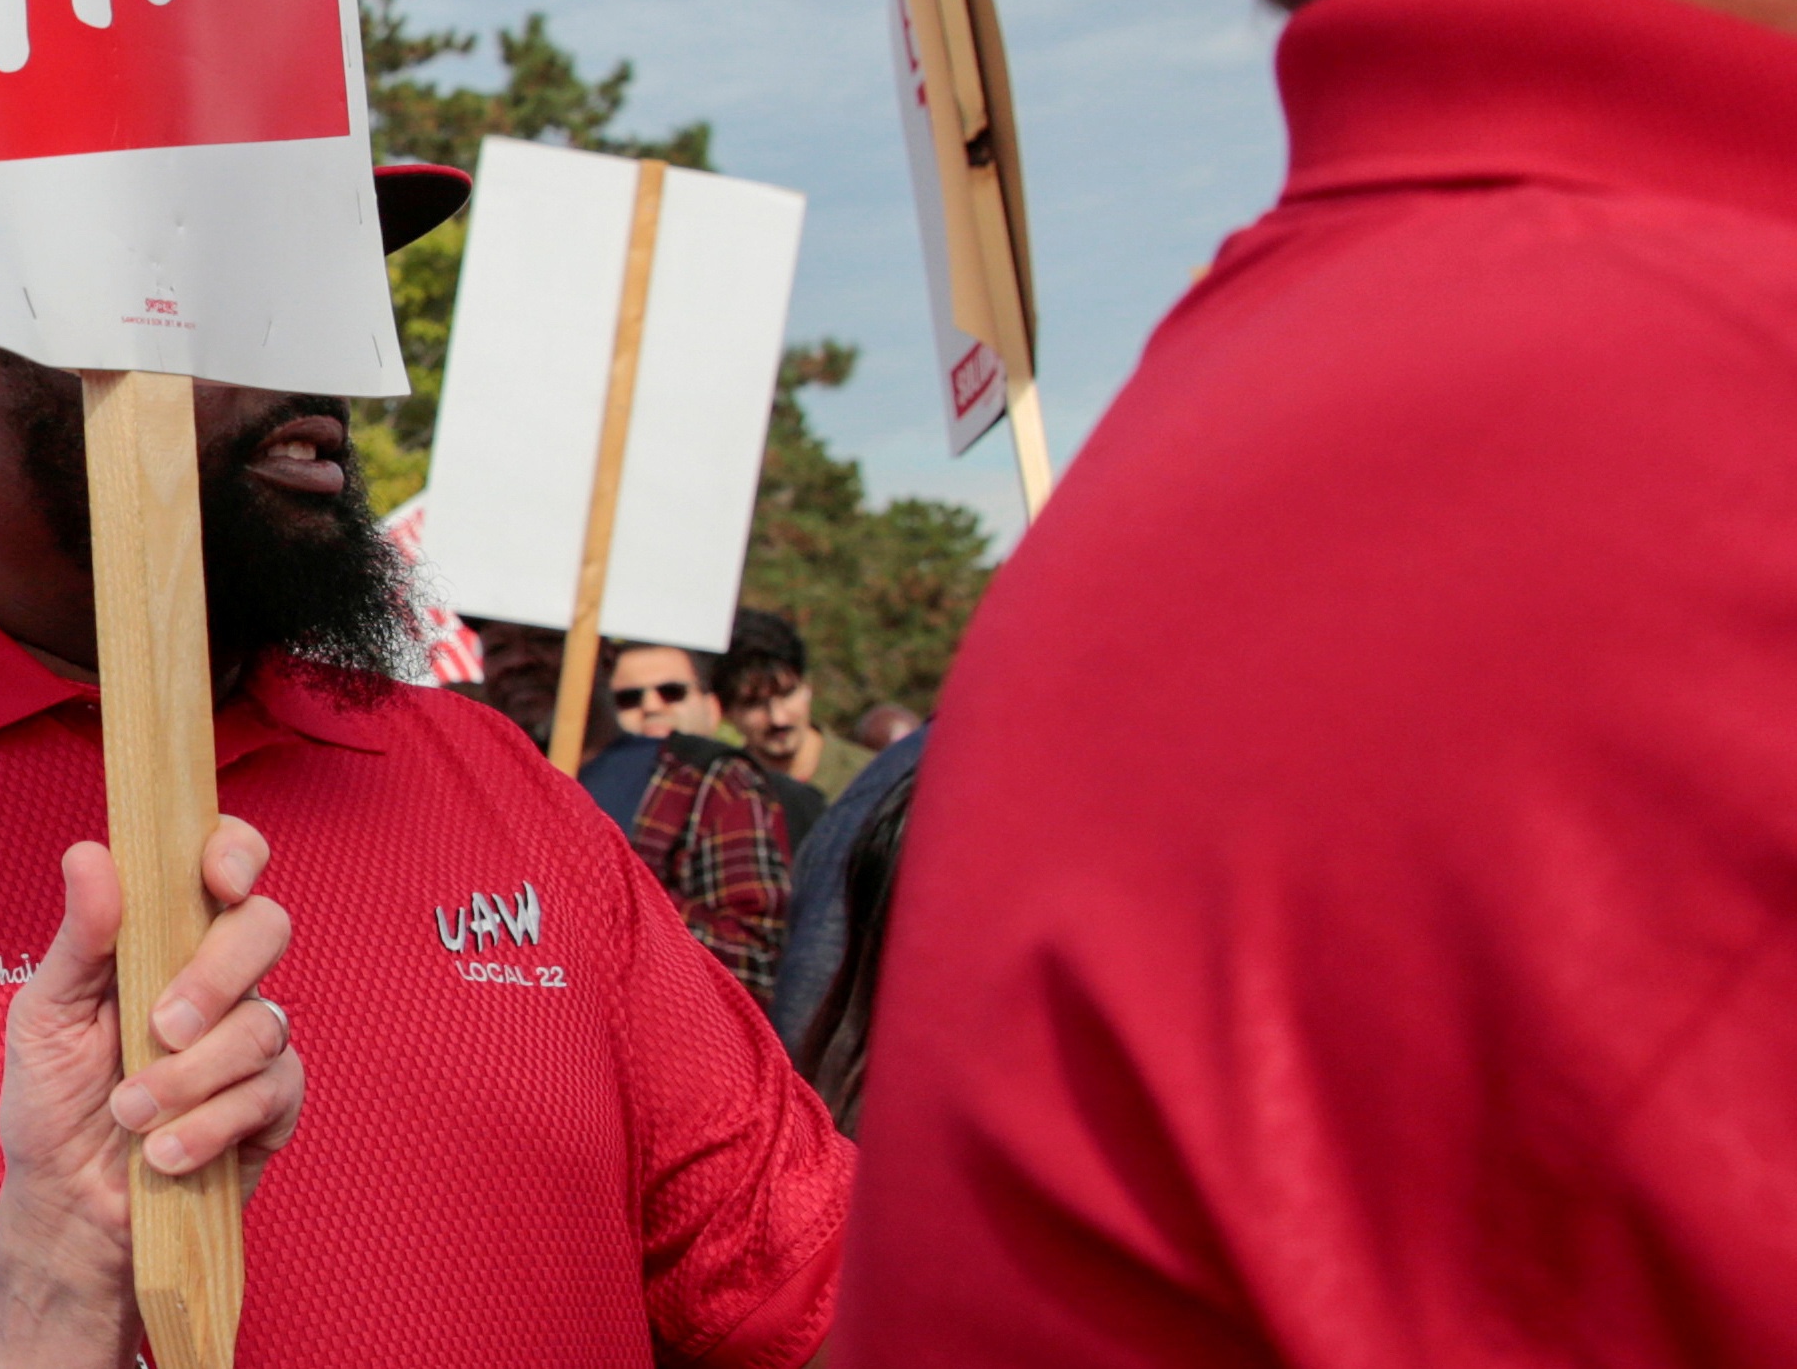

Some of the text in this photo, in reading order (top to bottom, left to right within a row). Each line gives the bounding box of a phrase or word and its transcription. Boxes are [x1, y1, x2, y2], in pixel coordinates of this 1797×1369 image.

[436, 880, 541, 954] UAW
[455, 960, 567, 988] LOCAL 22
